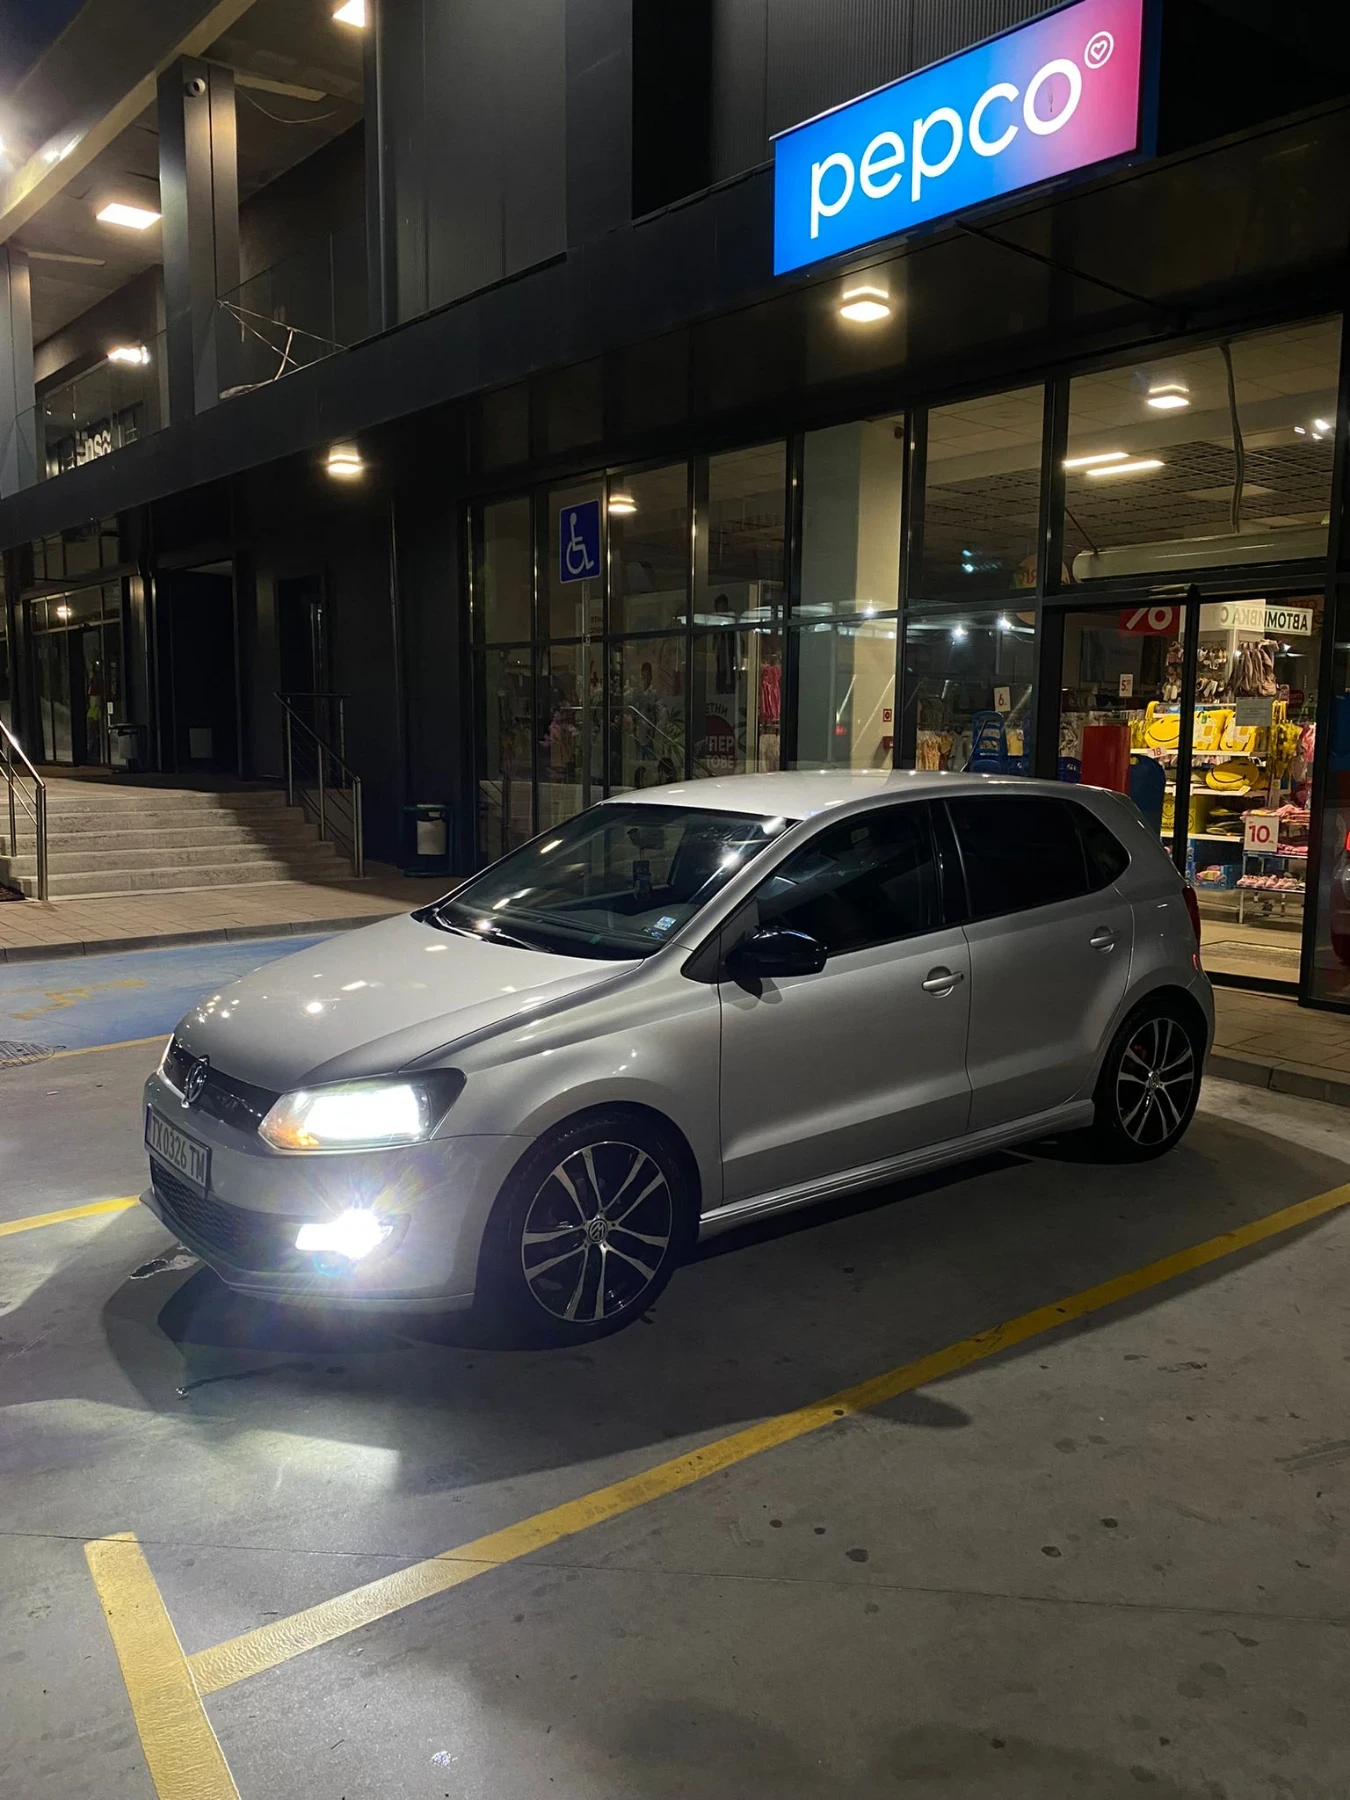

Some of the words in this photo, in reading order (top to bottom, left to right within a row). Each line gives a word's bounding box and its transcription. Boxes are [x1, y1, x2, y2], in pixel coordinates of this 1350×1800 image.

[810, 58, 1082, 239] pepco
[704, 702, 728, 718] ЕТНИ
[706, 735, 734, 752] ПЕР
[705, 754, 734, 769] ТОВЕ
[1248, 825, 1270, 843] 10
